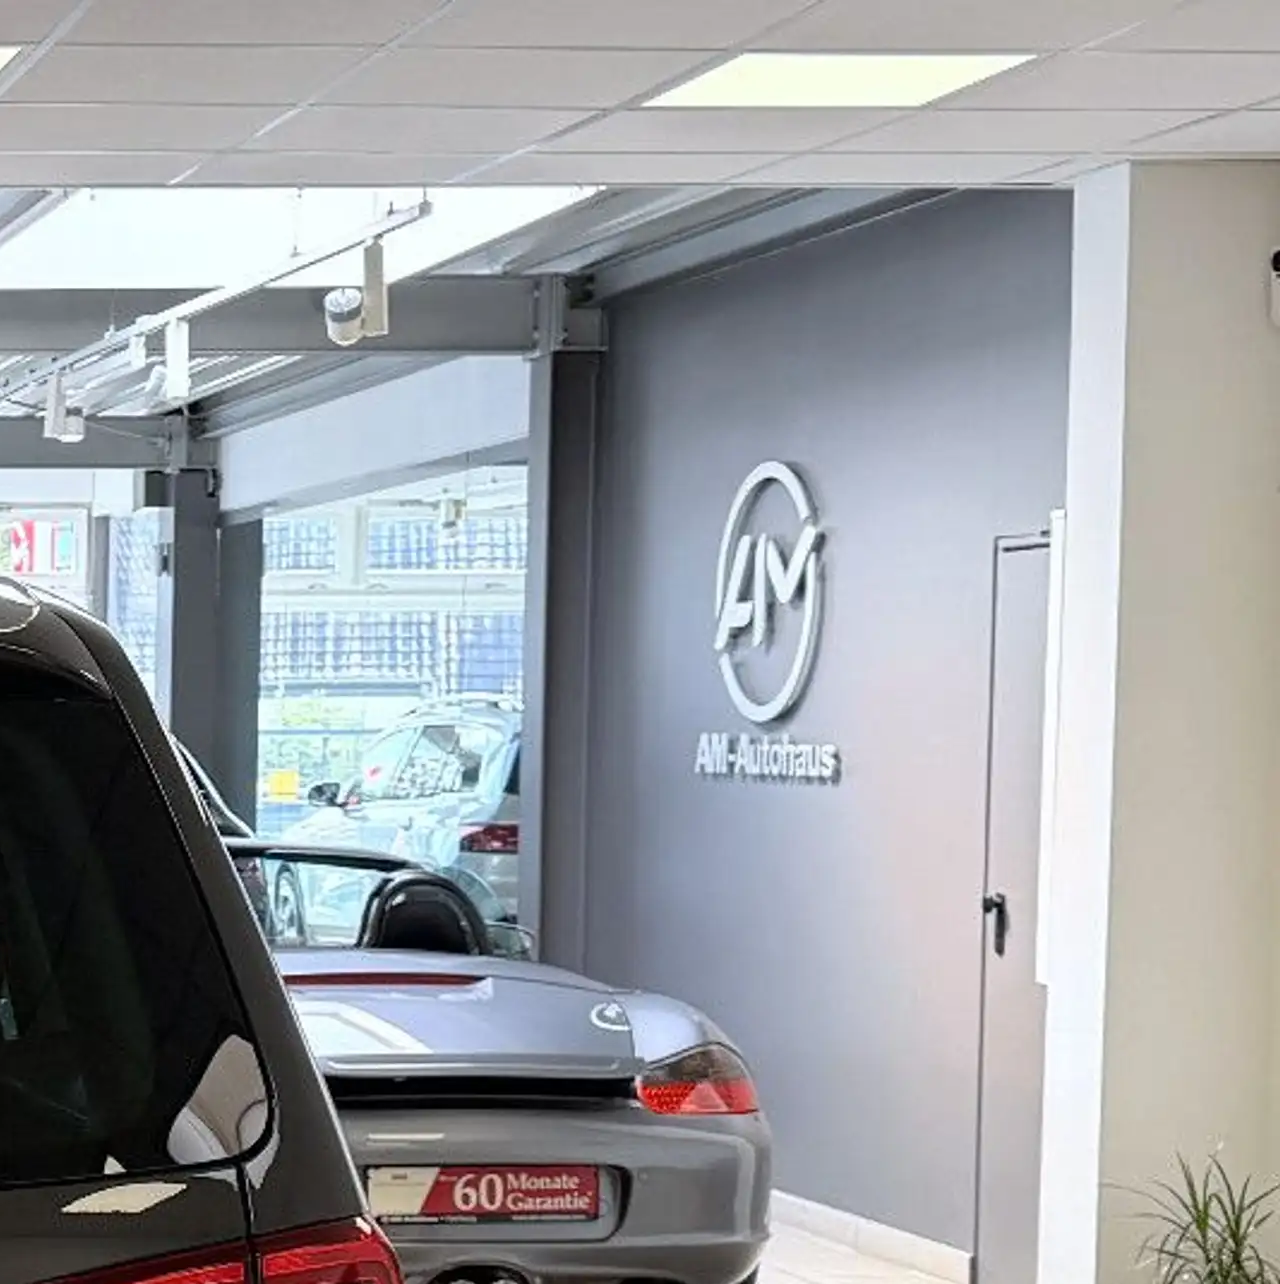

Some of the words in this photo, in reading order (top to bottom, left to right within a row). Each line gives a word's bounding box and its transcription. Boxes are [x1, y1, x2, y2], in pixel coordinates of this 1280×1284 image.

[714, 525, 816, 649] AM
[694, 732, 839, 778] AM-Autohaus
[453, 1173, 504, 1211] 60
[506, 1173, 580, 1190] Monate
